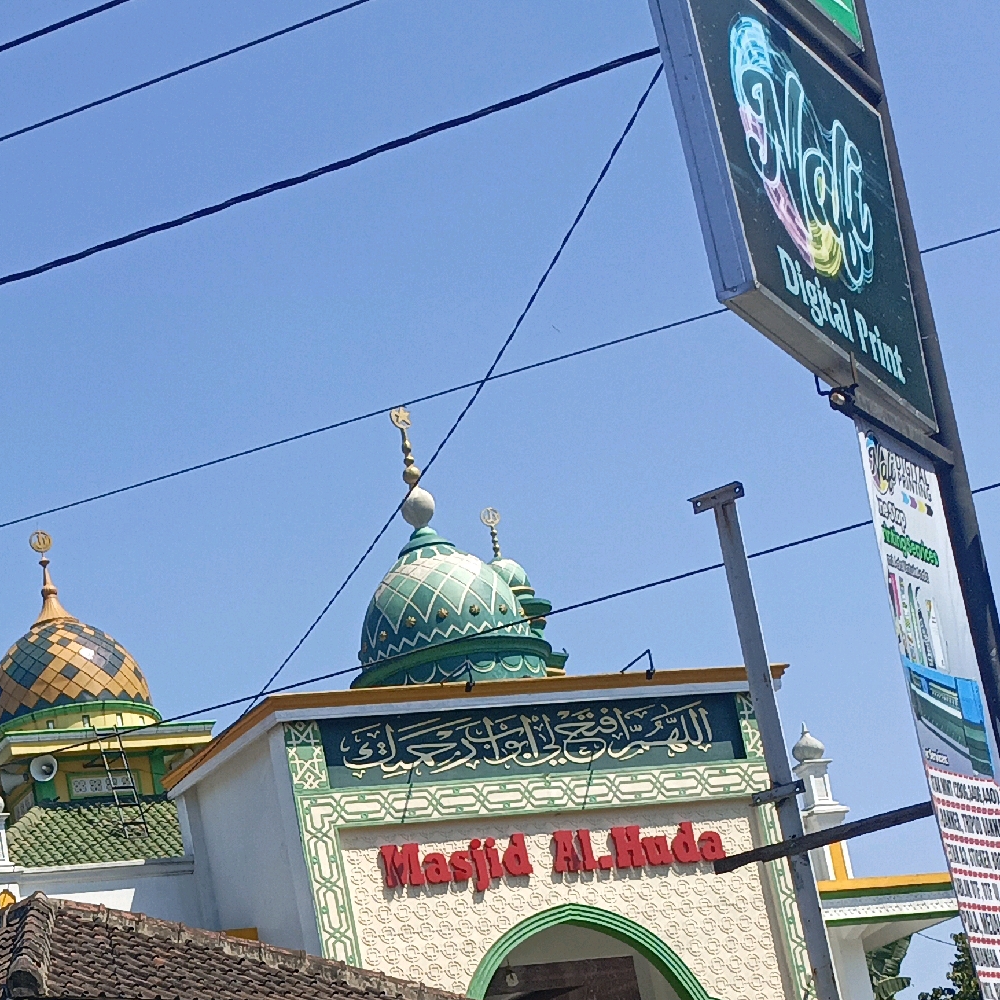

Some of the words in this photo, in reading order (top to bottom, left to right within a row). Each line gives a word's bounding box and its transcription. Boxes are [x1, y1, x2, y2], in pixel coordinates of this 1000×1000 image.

[777, 245, 854, 343] Digital
[854, 308, 906, 384] Print
[380, 833, 533, 892] Masjid
